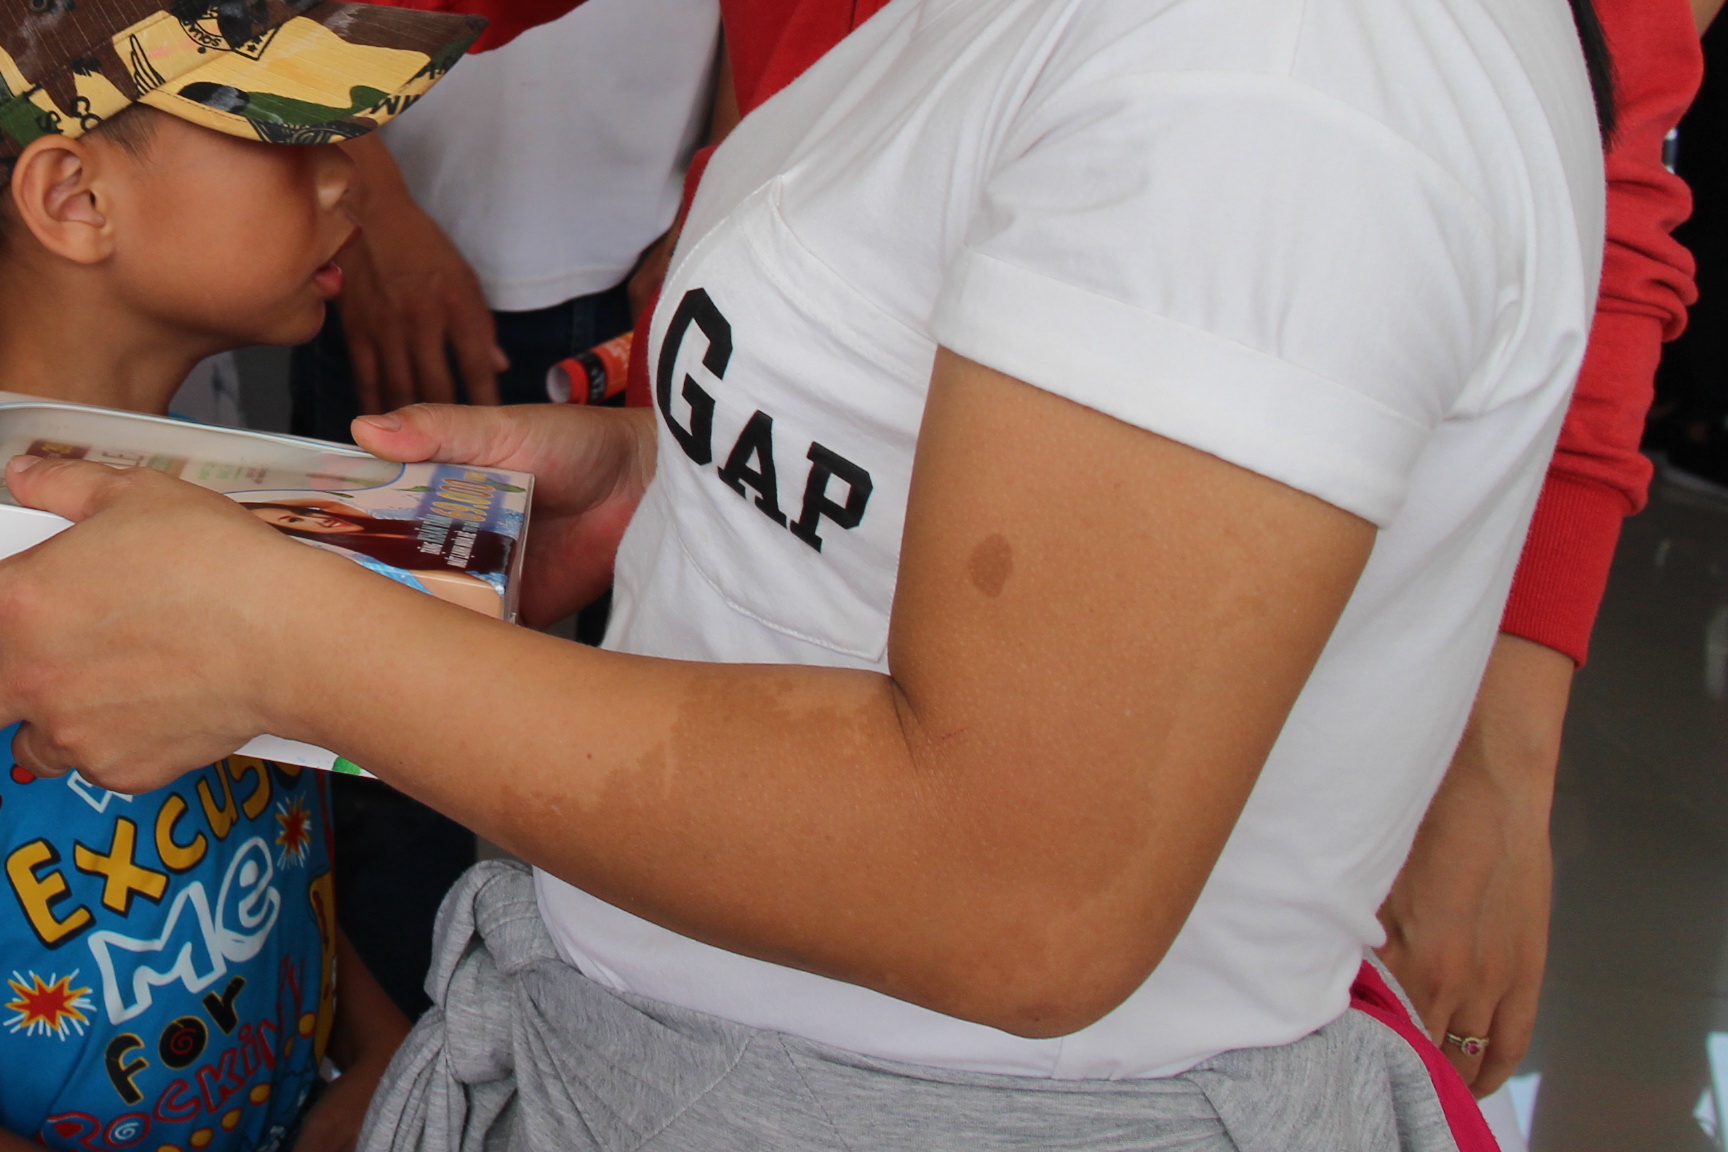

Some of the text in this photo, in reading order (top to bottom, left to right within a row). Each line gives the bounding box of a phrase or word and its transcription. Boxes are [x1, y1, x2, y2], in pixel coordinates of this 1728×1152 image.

[430, 478, 497, 522] 69.000
[656, 287, 874, 554] GAP
[4, 753, 304, 950] EXCUS
